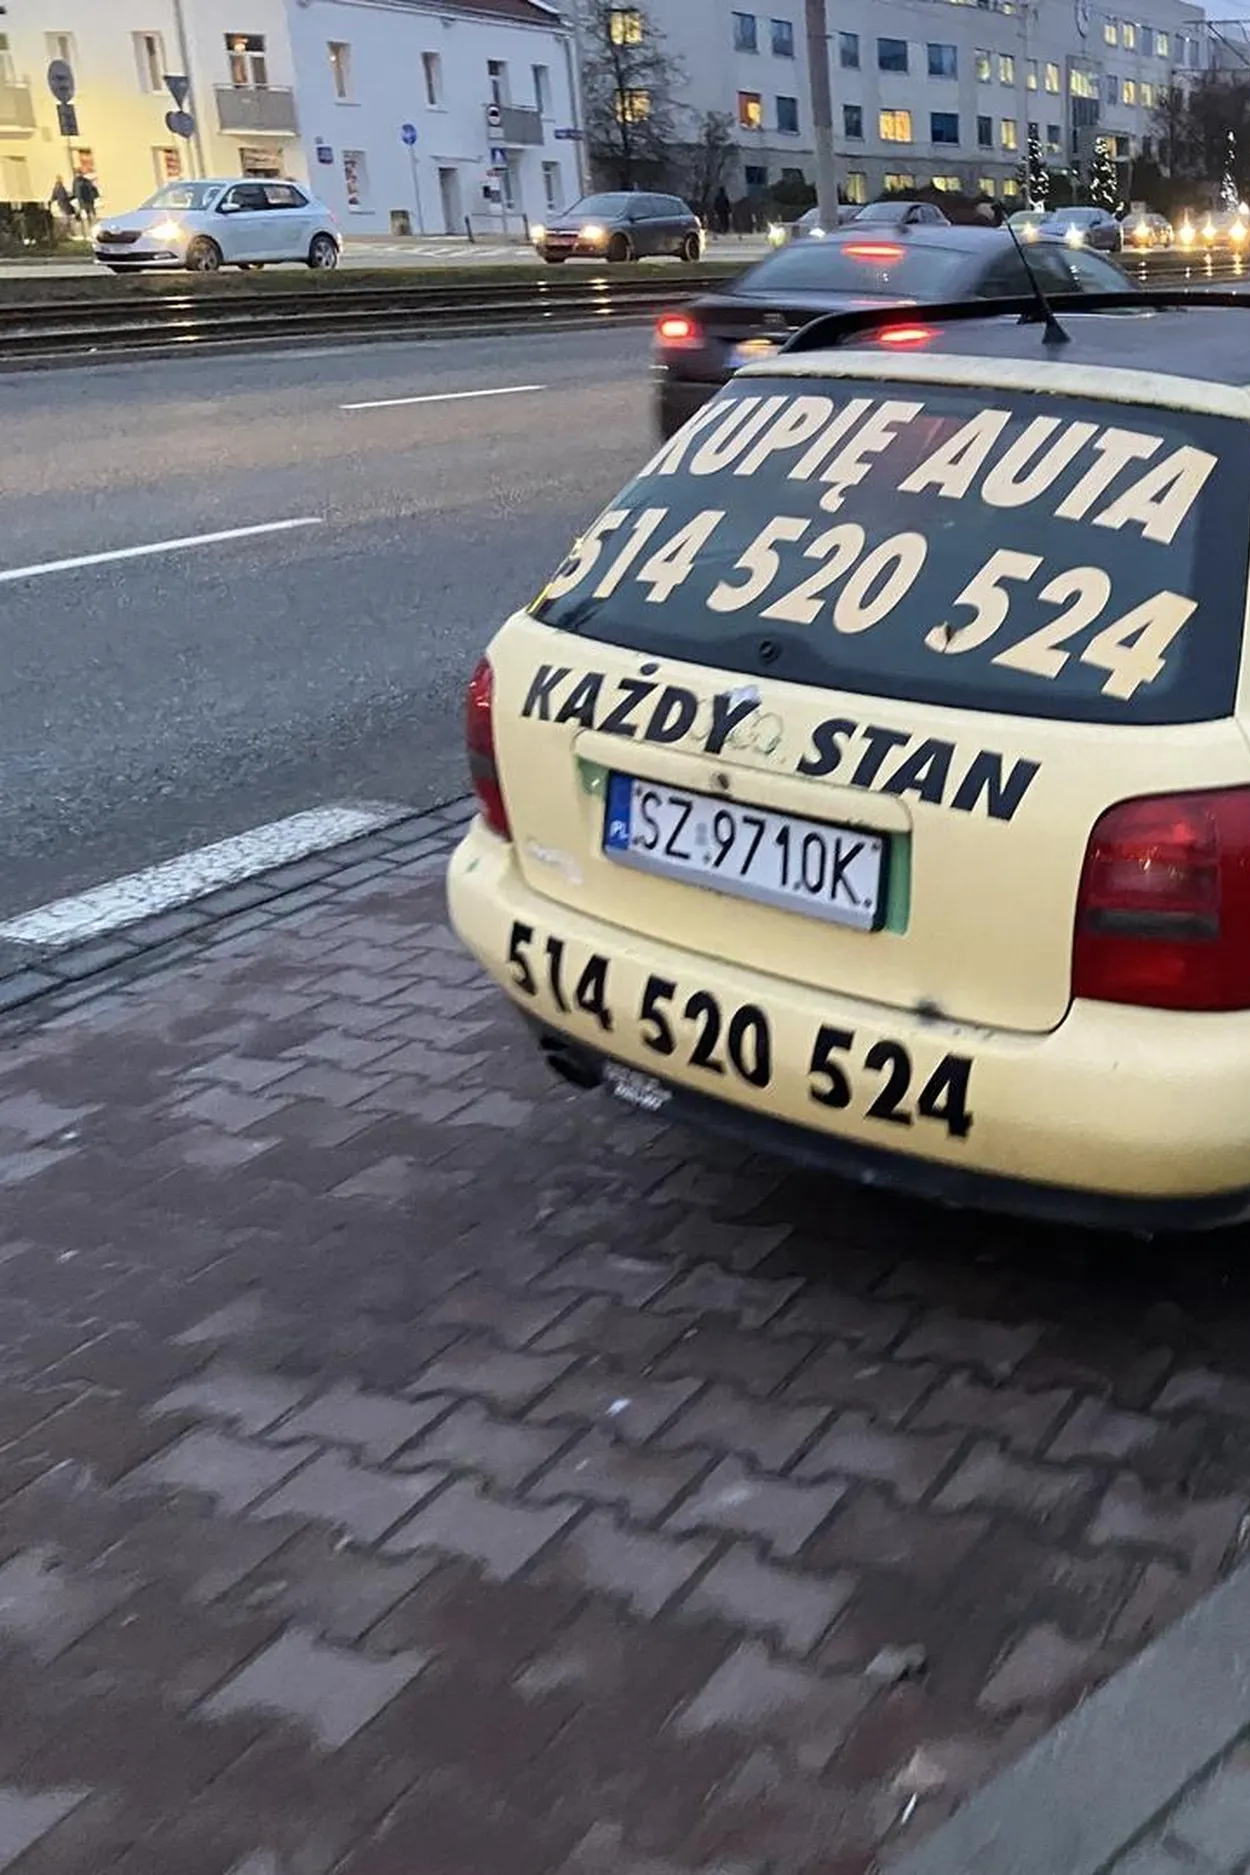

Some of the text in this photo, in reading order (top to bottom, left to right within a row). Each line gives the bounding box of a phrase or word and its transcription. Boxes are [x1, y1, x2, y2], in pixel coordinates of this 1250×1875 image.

[639, 395, 1218, 546] KUPIĘ AUTA
[547, 508, 1198, 700] 514 520 524
[520, 663, 1043, 821] KAŻDY STAN
[609, 820, 628, 840] PL
[640, 791, 865, 904] SZ 9710K
[505, 920, 614, 1033] 514
[639, 972, 774, 1089] 520
[807, 1024, 976, 1141] 524
